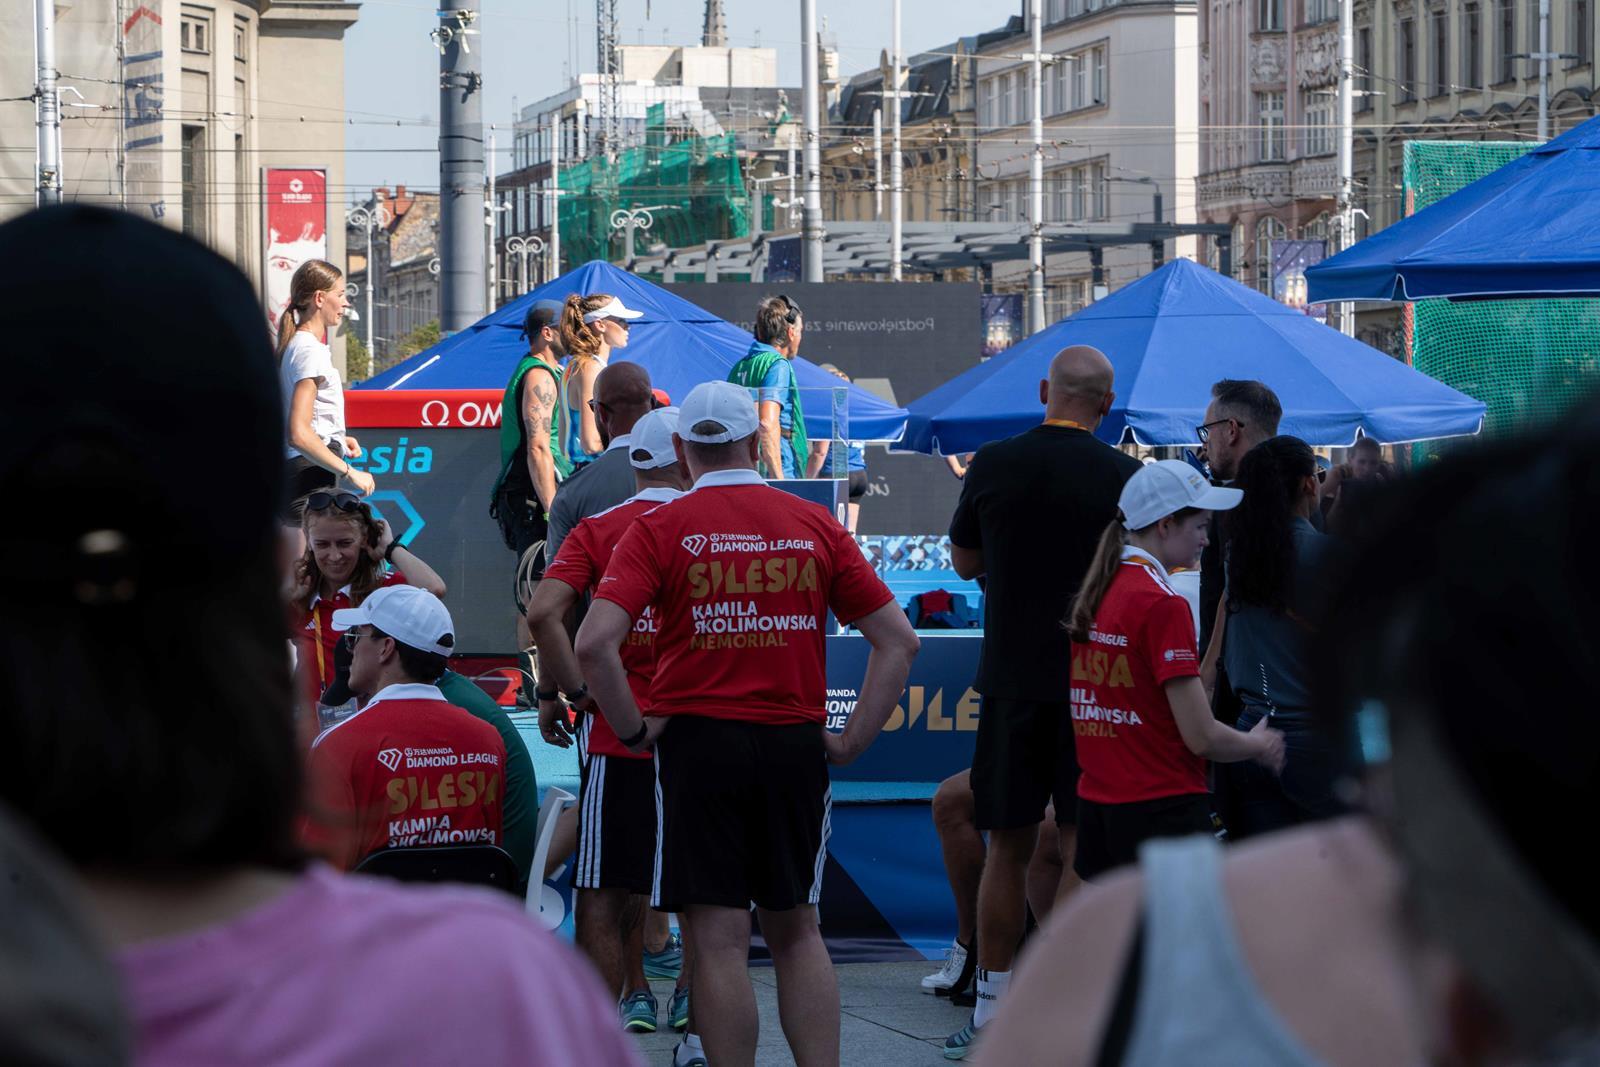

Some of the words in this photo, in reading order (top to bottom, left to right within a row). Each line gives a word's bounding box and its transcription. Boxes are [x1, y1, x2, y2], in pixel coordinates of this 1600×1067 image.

[711, 541, 767, 553] DIAMOND
[770, 539, 815, 551] LEAGUE
[687, 557, 817, 599] SILESIA
[692, 601, 758, 620] KAMILA
[694, 615, 817, 635] SKOLIMOWSKA
[690, 632, 788, 650] MEMORIAL
[406, 755, 458, 768] DIAMOND
[461, 753, 499, 766] LEAGUE
[389, 815, 451, 837] KAMILA
